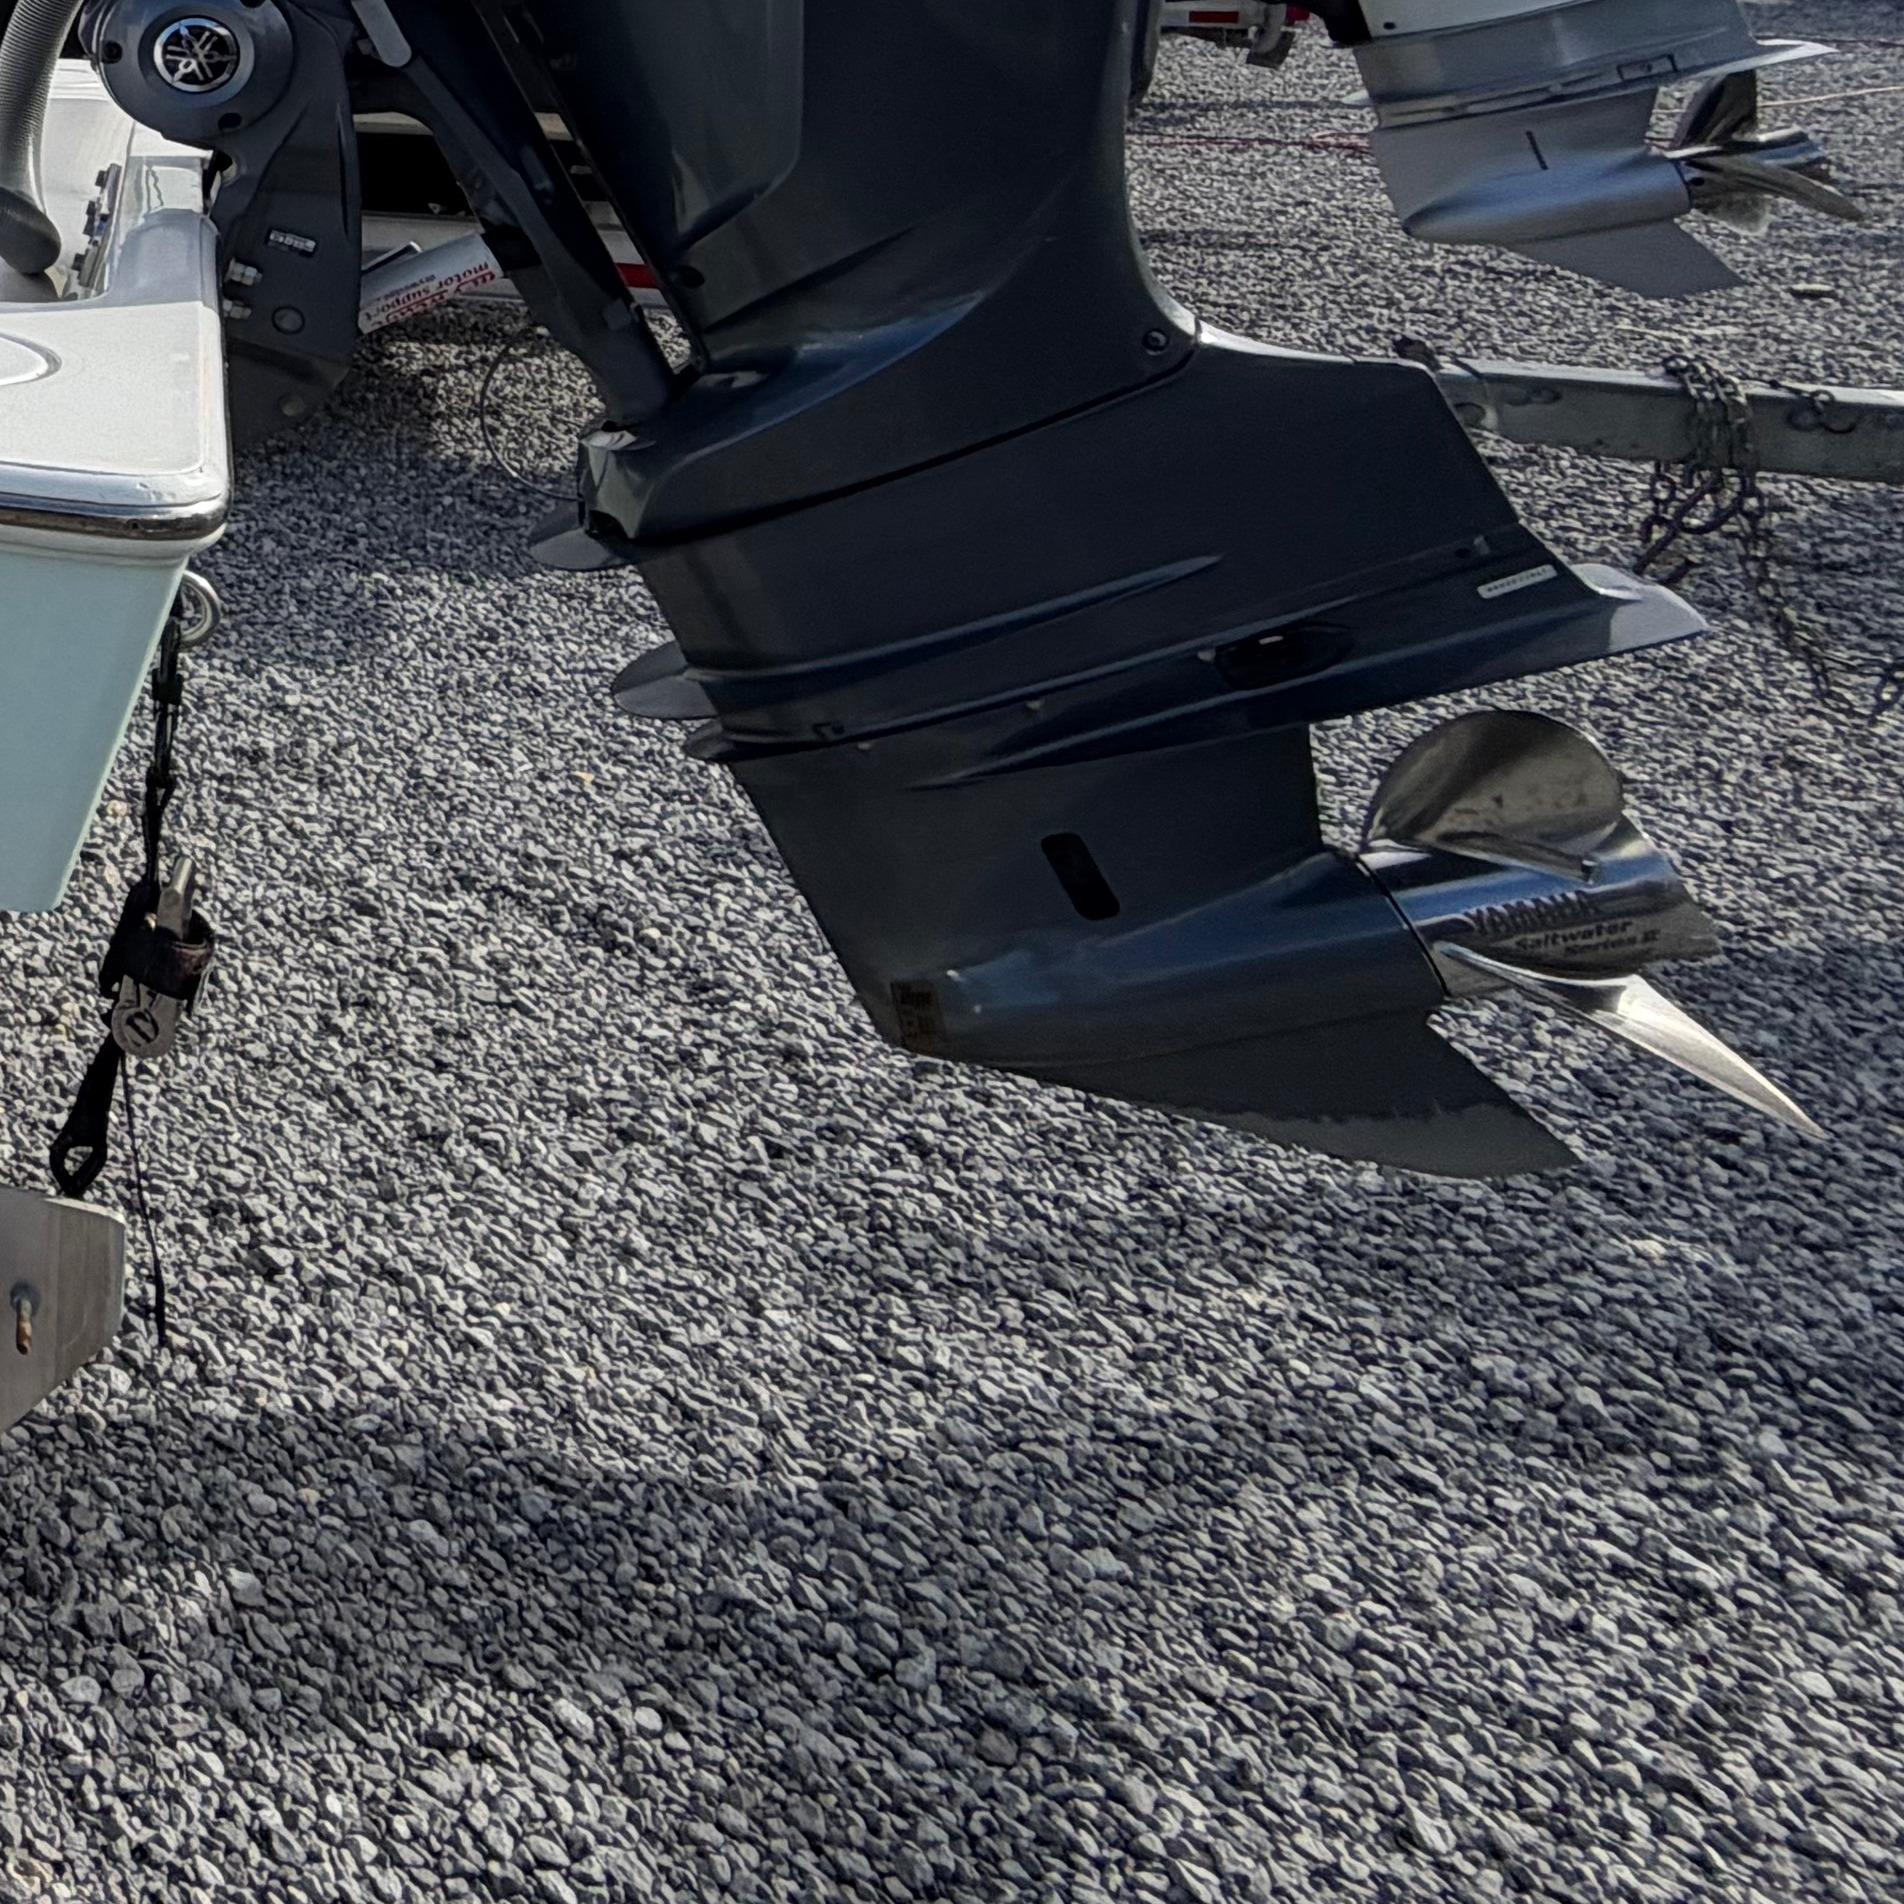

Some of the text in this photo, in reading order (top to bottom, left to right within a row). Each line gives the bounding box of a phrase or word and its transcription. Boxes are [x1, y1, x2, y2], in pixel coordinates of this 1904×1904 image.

[438, 261, 490, 289] motor
[364, 287, 431, 322] support
[1463, 890, 1598, 938] YAMAHA
[1514, 918, 1635, 952] Saltwater
